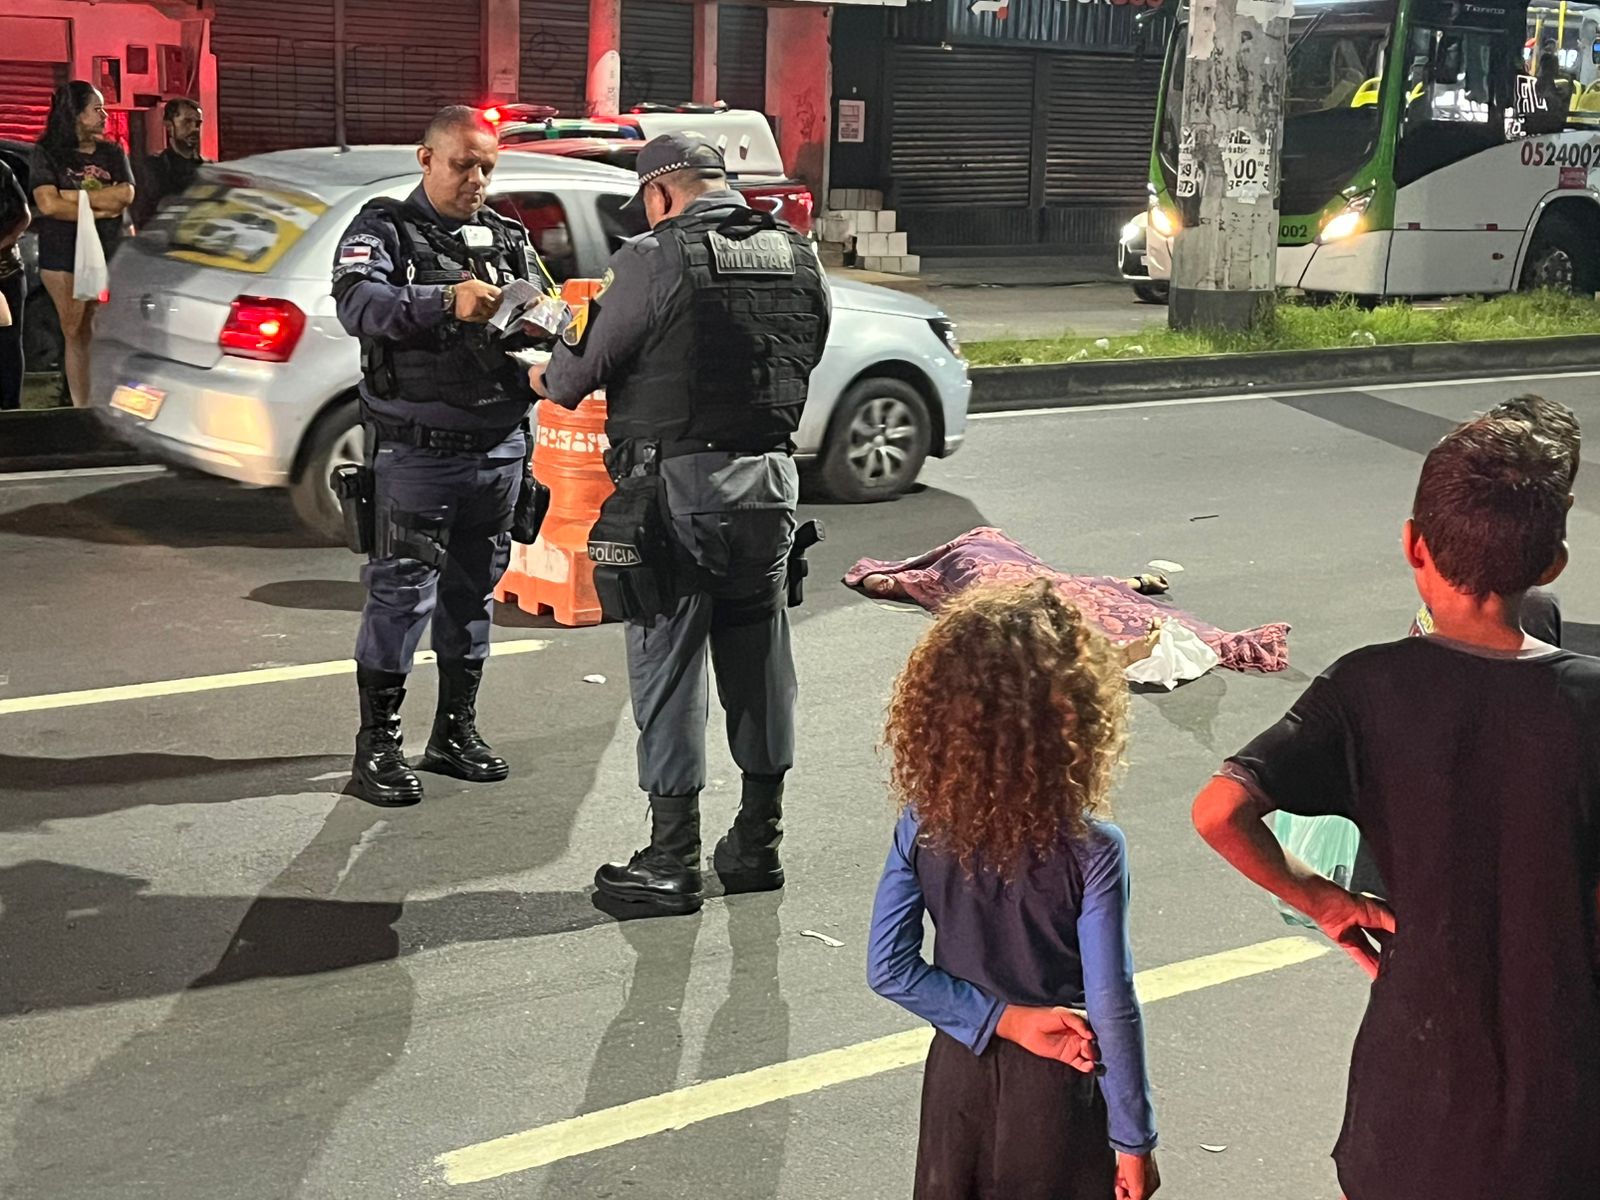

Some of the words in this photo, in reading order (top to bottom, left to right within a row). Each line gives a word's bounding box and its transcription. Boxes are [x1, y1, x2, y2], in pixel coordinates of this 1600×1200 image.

[1464, 4, 1506, 15] Torino
[1521, 141, 1600, 168] 0524002
[718, 251, 793, 269] MILITAR
